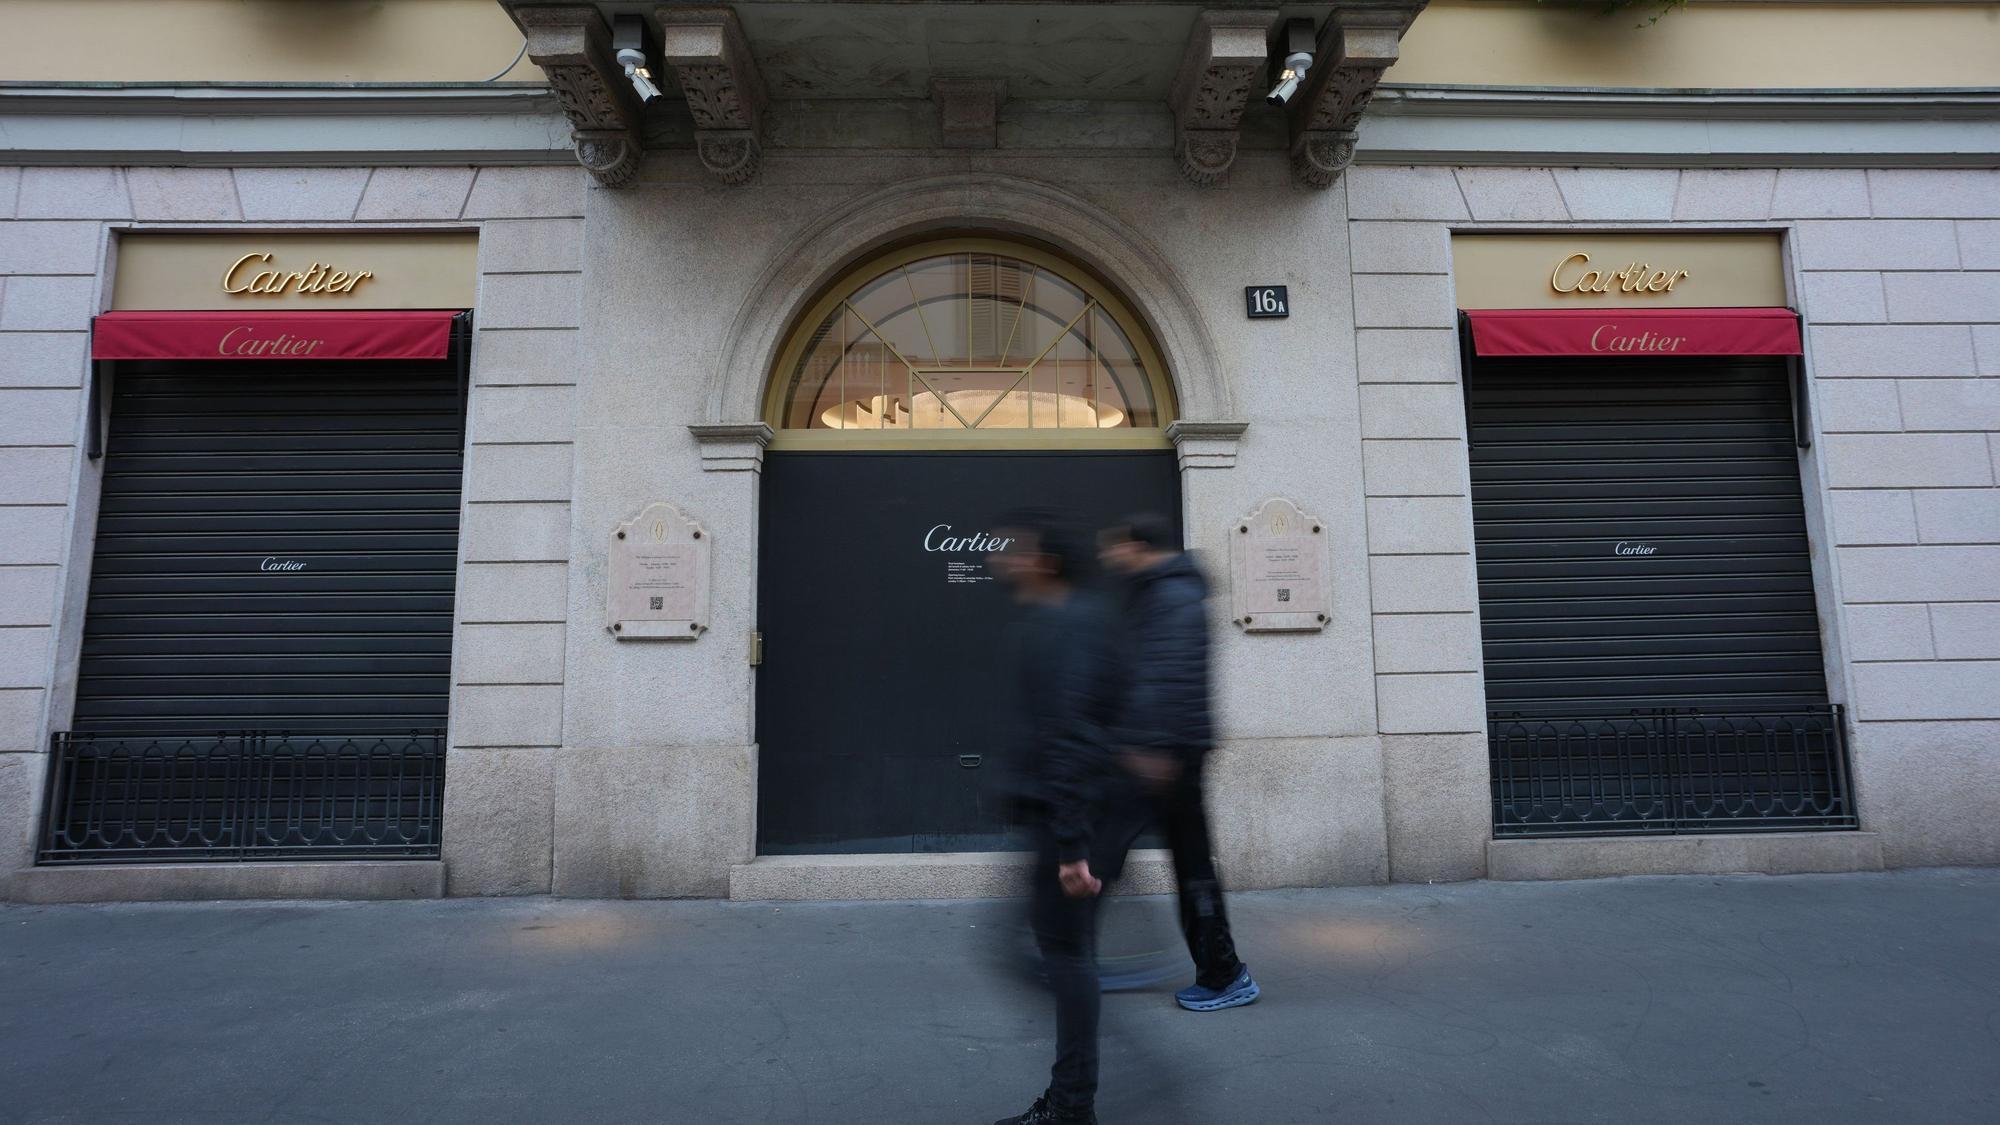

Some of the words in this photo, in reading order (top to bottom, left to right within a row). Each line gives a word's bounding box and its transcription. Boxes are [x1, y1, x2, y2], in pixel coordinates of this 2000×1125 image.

[223, 252, 374, 294] Cartier
[1551, 252, 1690, 293] Cartier
[218, 326, 324, 356] Cartier
[1591, 324, 1687, 352] Cartier
[924, 523, 1015, 552] Cartier
[1615, 541, 1658, 556] Cartier
[260, 556, 307, 571] Cartier
